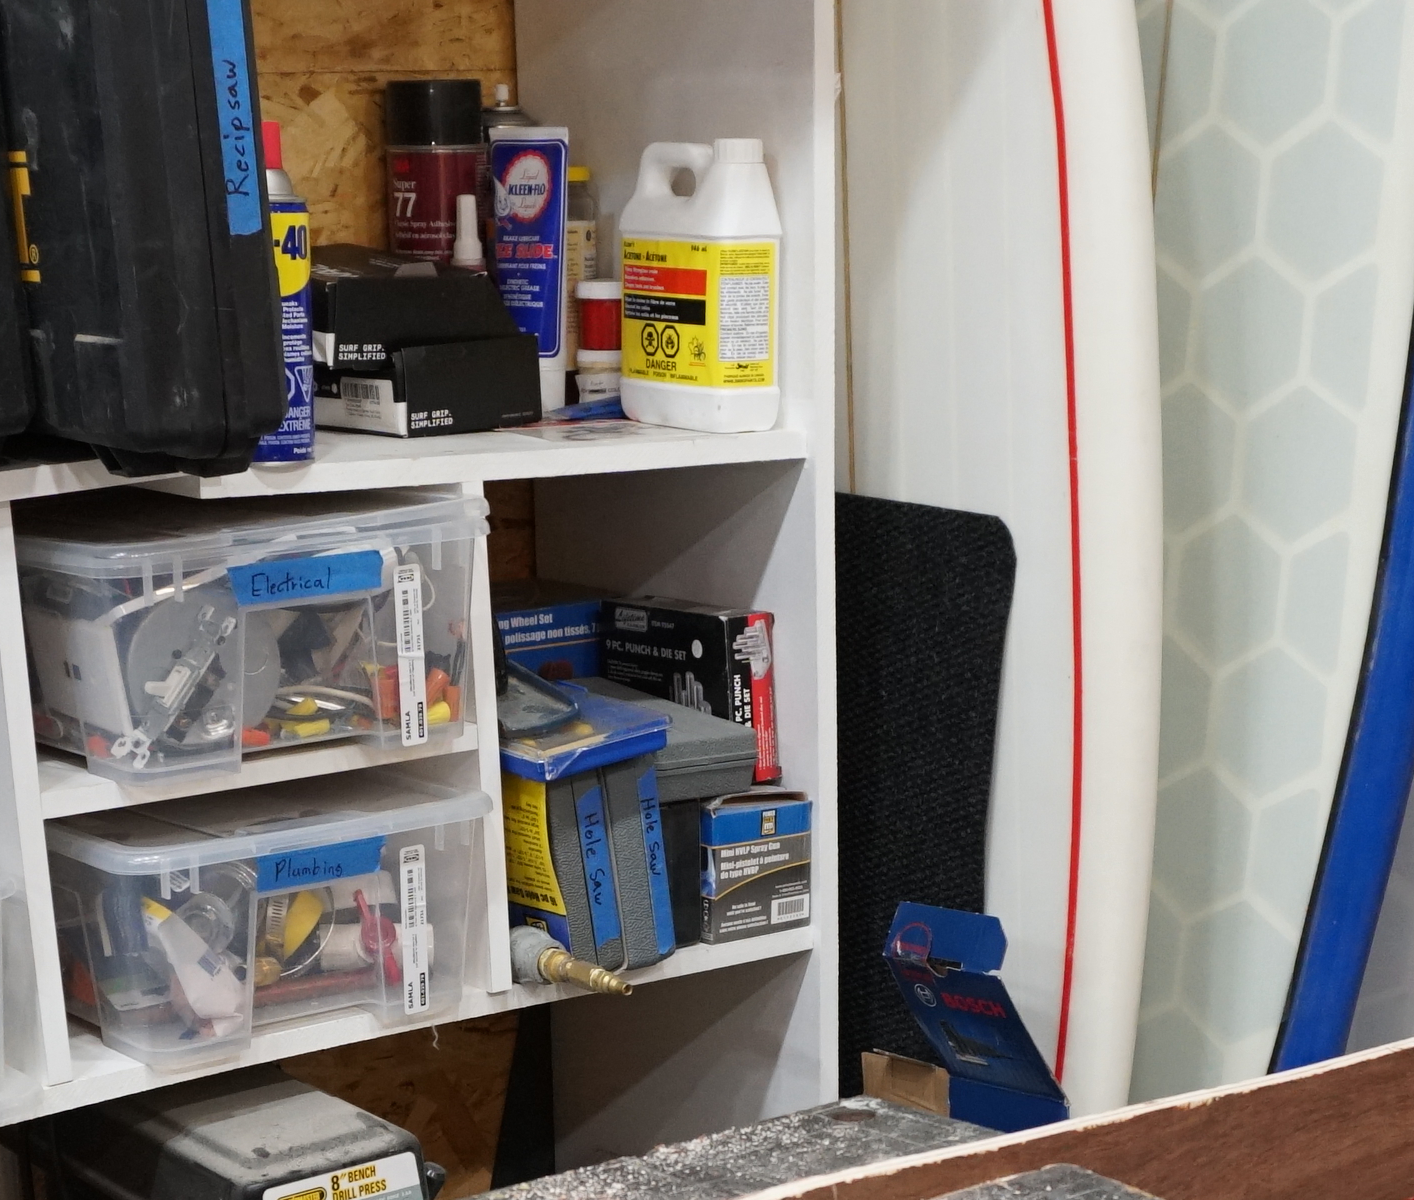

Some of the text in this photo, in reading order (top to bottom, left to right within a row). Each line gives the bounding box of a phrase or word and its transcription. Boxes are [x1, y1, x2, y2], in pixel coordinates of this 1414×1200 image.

[393, 180, 416, 191] Super
[508, 183, 546, 196] KLEEN-FLO
[393, 192, 417, 217] 77
[273, 225, 308, 260] -40
[515, 243, 554, 258] SLIDE
[338, 352, 386, 361] SIMPLIFIED
[339, 343, 385, 352] SURF GRIP.
[645, 358, 677, 372] DANGER
[410, 409, 452, 421] SURF GRIP.
[410, 417, 454, 430] SIMPLIFIED
[251, 567, 331, 597] Electrical
[510, 615, 538, 628] Wheel
[538, 613, 553, 625] Set
[504, 630, 546, 646] polissage
[547, 628, 563, 639] non
[605, 639, 611, 649] 9
[625, 642, 651, 656] PUNCH
[653, 647, 659, 657] &
[660, 648, 673, 659] DIE
[674, 650, 687, 661] SET
[733, 674, 743, 722] PC. PUNCH
[744, 703, 752, 719] DIE
[640, 797, 662, 876] Hole Saw
[585, 812, 606, 906] Hole Saw
[720, 849, 735, 859] Mini
[751, 844, 768, 854] Spray
[768, 841, 781, 851] Gun
[720, 857, 759, 871] Mini-pistolet
[764, 852, 790, 865] peinture
[720, 871, 729, 880] de
[729, 869, 743, 879] type
[940, 992, 1007, 1019] BOSCH
[347, 1165, 377, 1183] BENCH
[358, 1179, 387, 1197] PRESS
